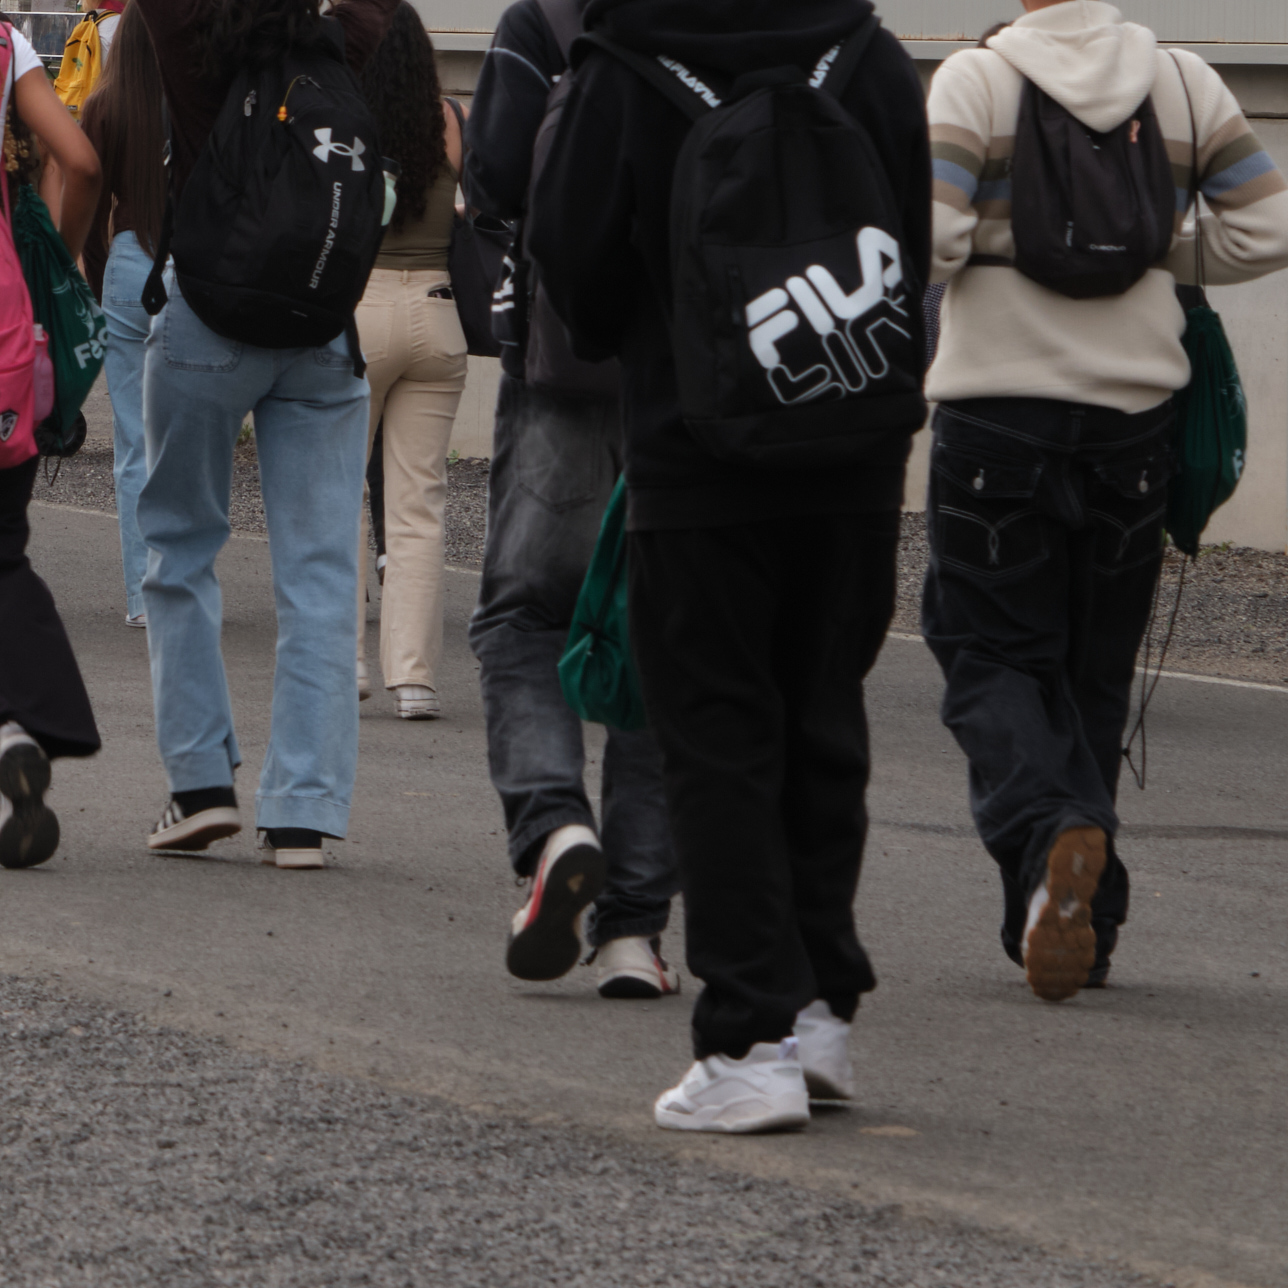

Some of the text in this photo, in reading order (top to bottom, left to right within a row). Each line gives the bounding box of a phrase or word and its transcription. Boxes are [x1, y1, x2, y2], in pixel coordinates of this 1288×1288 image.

[308, 181, 343, 289] UNDER ARMOUR
[745, 226, 903, 370] FILA
